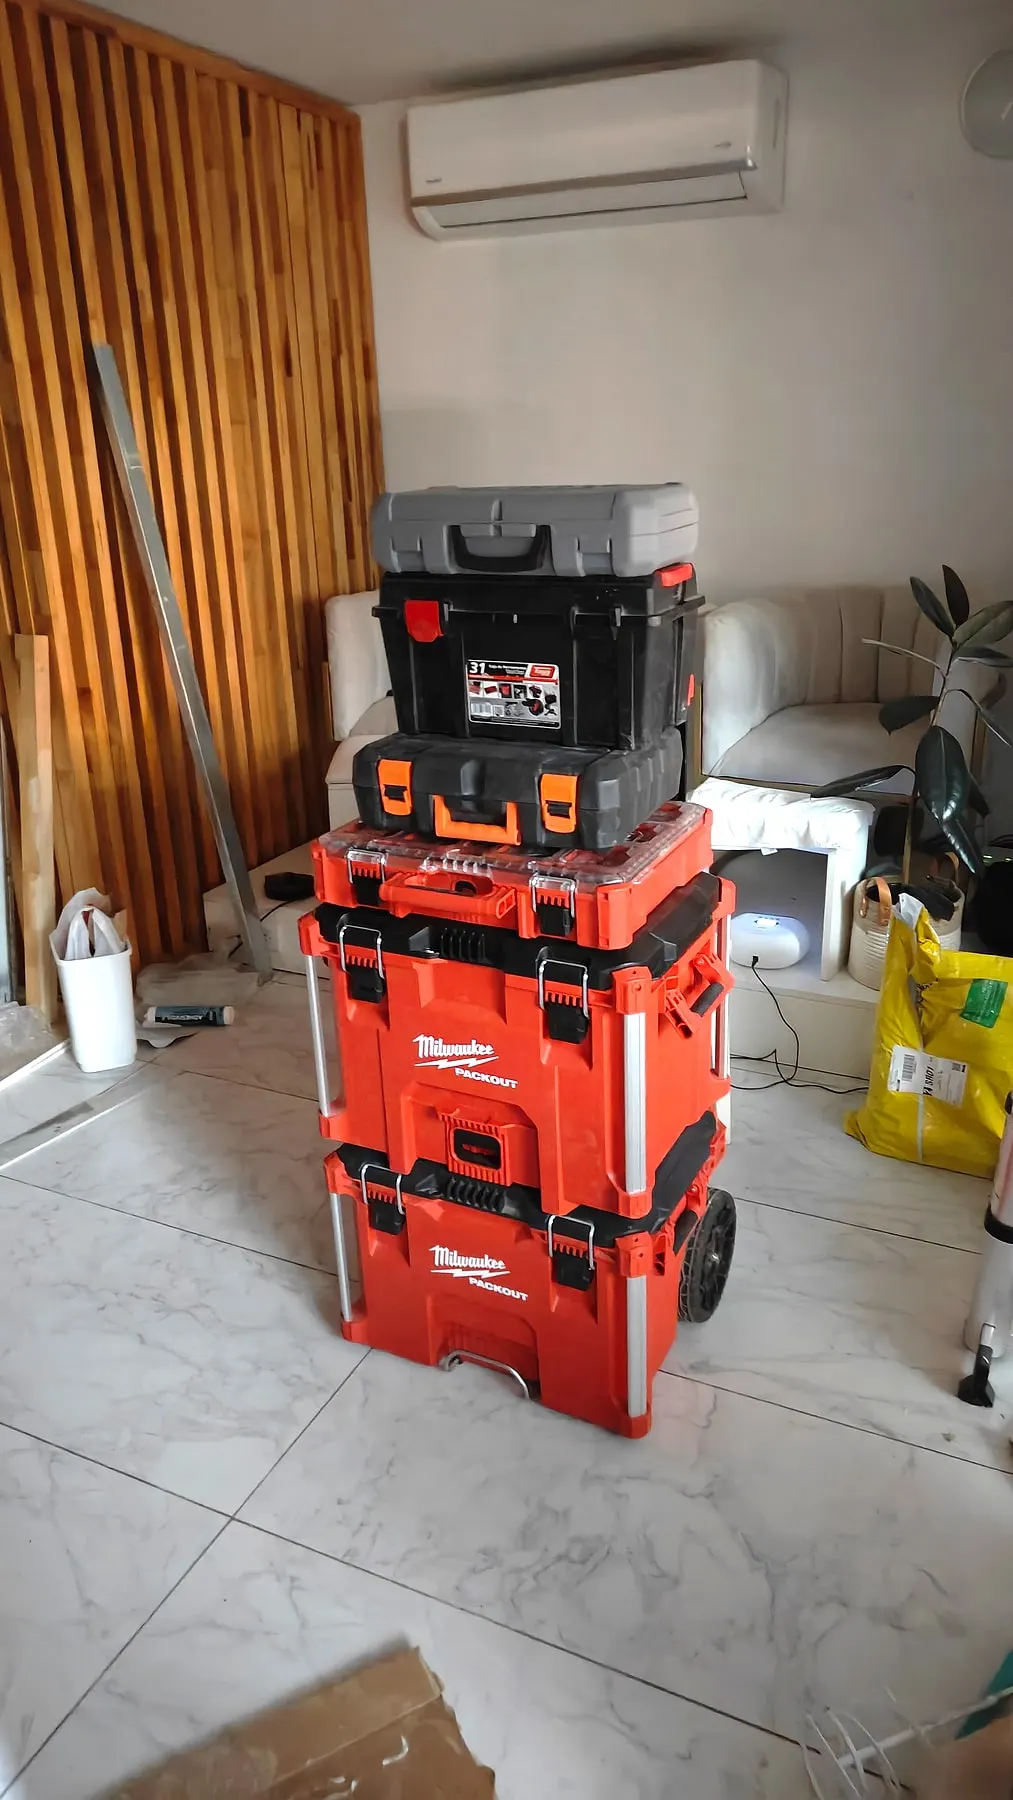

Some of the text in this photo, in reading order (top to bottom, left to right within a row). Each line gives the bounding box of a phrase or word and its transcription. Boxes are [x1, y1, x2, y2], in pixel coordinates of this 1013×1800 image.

[469, 662, 486, 674] 31
[412, 1034, 495, 1058] Milwaukee
[454, 1067, 519, 1089] PACKOUT
[429, 1244, 507, 1270] Milwaukee
[468, 1276, 529, 1301] PACKOUT
